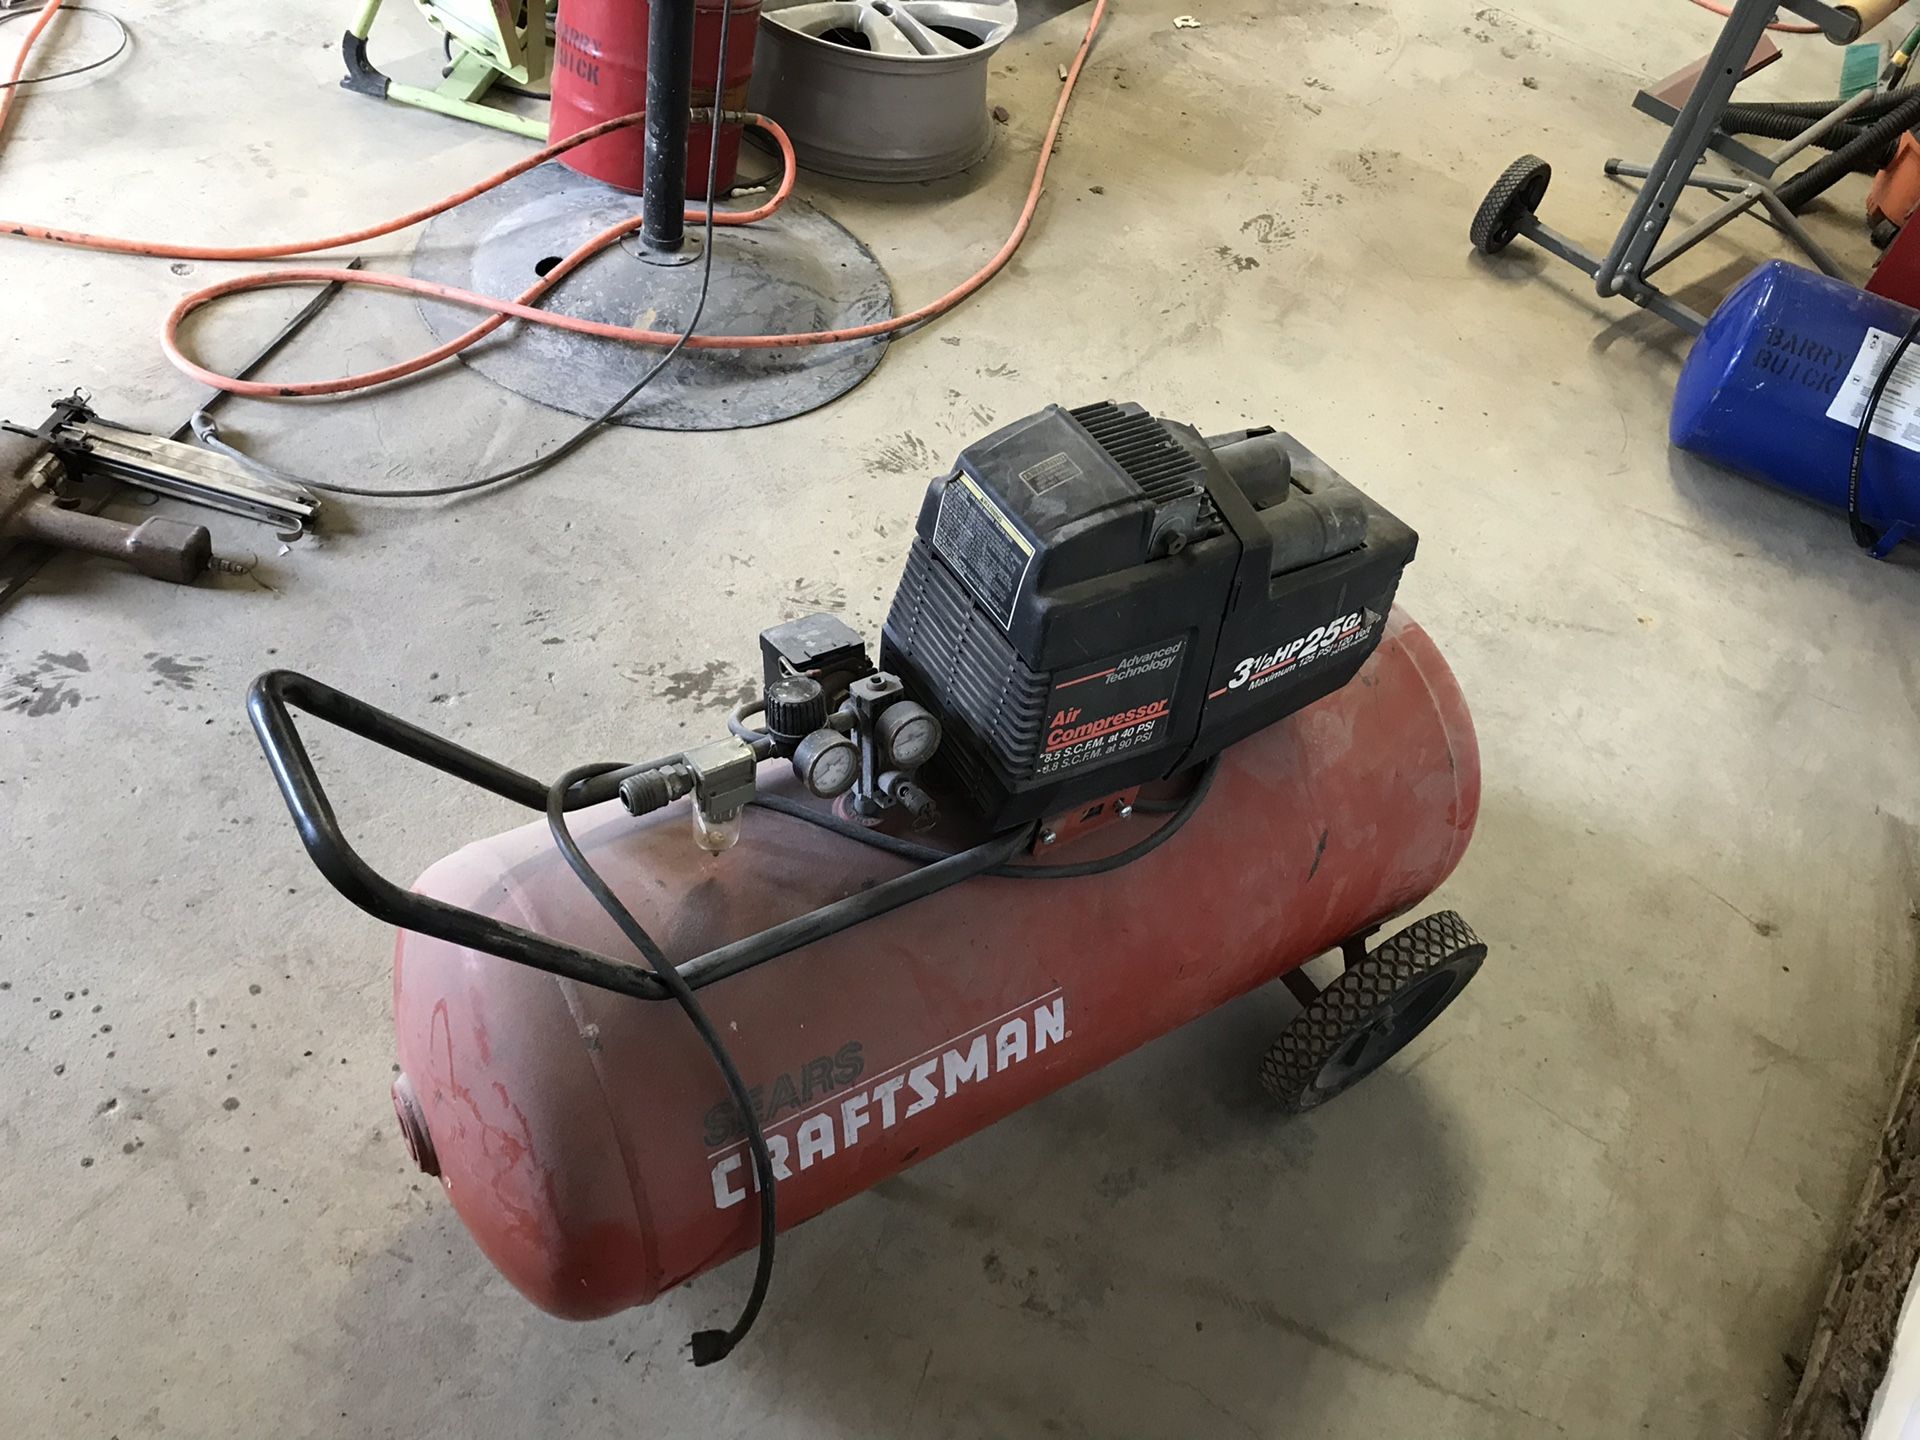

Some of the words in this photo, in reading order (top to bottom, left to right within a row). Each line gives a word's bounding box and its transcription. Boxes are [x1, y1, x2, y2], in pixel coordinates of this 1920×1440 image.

[560, 46, 600, 86] UICK
[1766, 327, 1847, 371] BARRY
[1753, 348, 1837, 393] BUICK
[1105, 655, 1176, 684] Technology
[1117, 641, 1182, 670] Advanced
[1248, 664, 1296, 690] Maximum
[1299, 653, 1316, 667] 125
[1316, 644, 1333, 659] PSI
[1047, 699, 1168, 746] Compressor
[1050, 706, 1081, 728] Air
[1061, 748, 1102, 768] S.C.F.M.
[1105, 744, 1116, 754] at
[1118, 738, 1132, 750] 90
[1133, 732, 1152, 745] PSI
[1063, 736, 1104, 757] S.C.F.M.
[1108, 732, 1118, 743] at
[1120, 727, 1135, 739] 40
[1136, 720, 1155, 734] PSI
[711, 997, 1065, 1209] CRAFTSMAN
